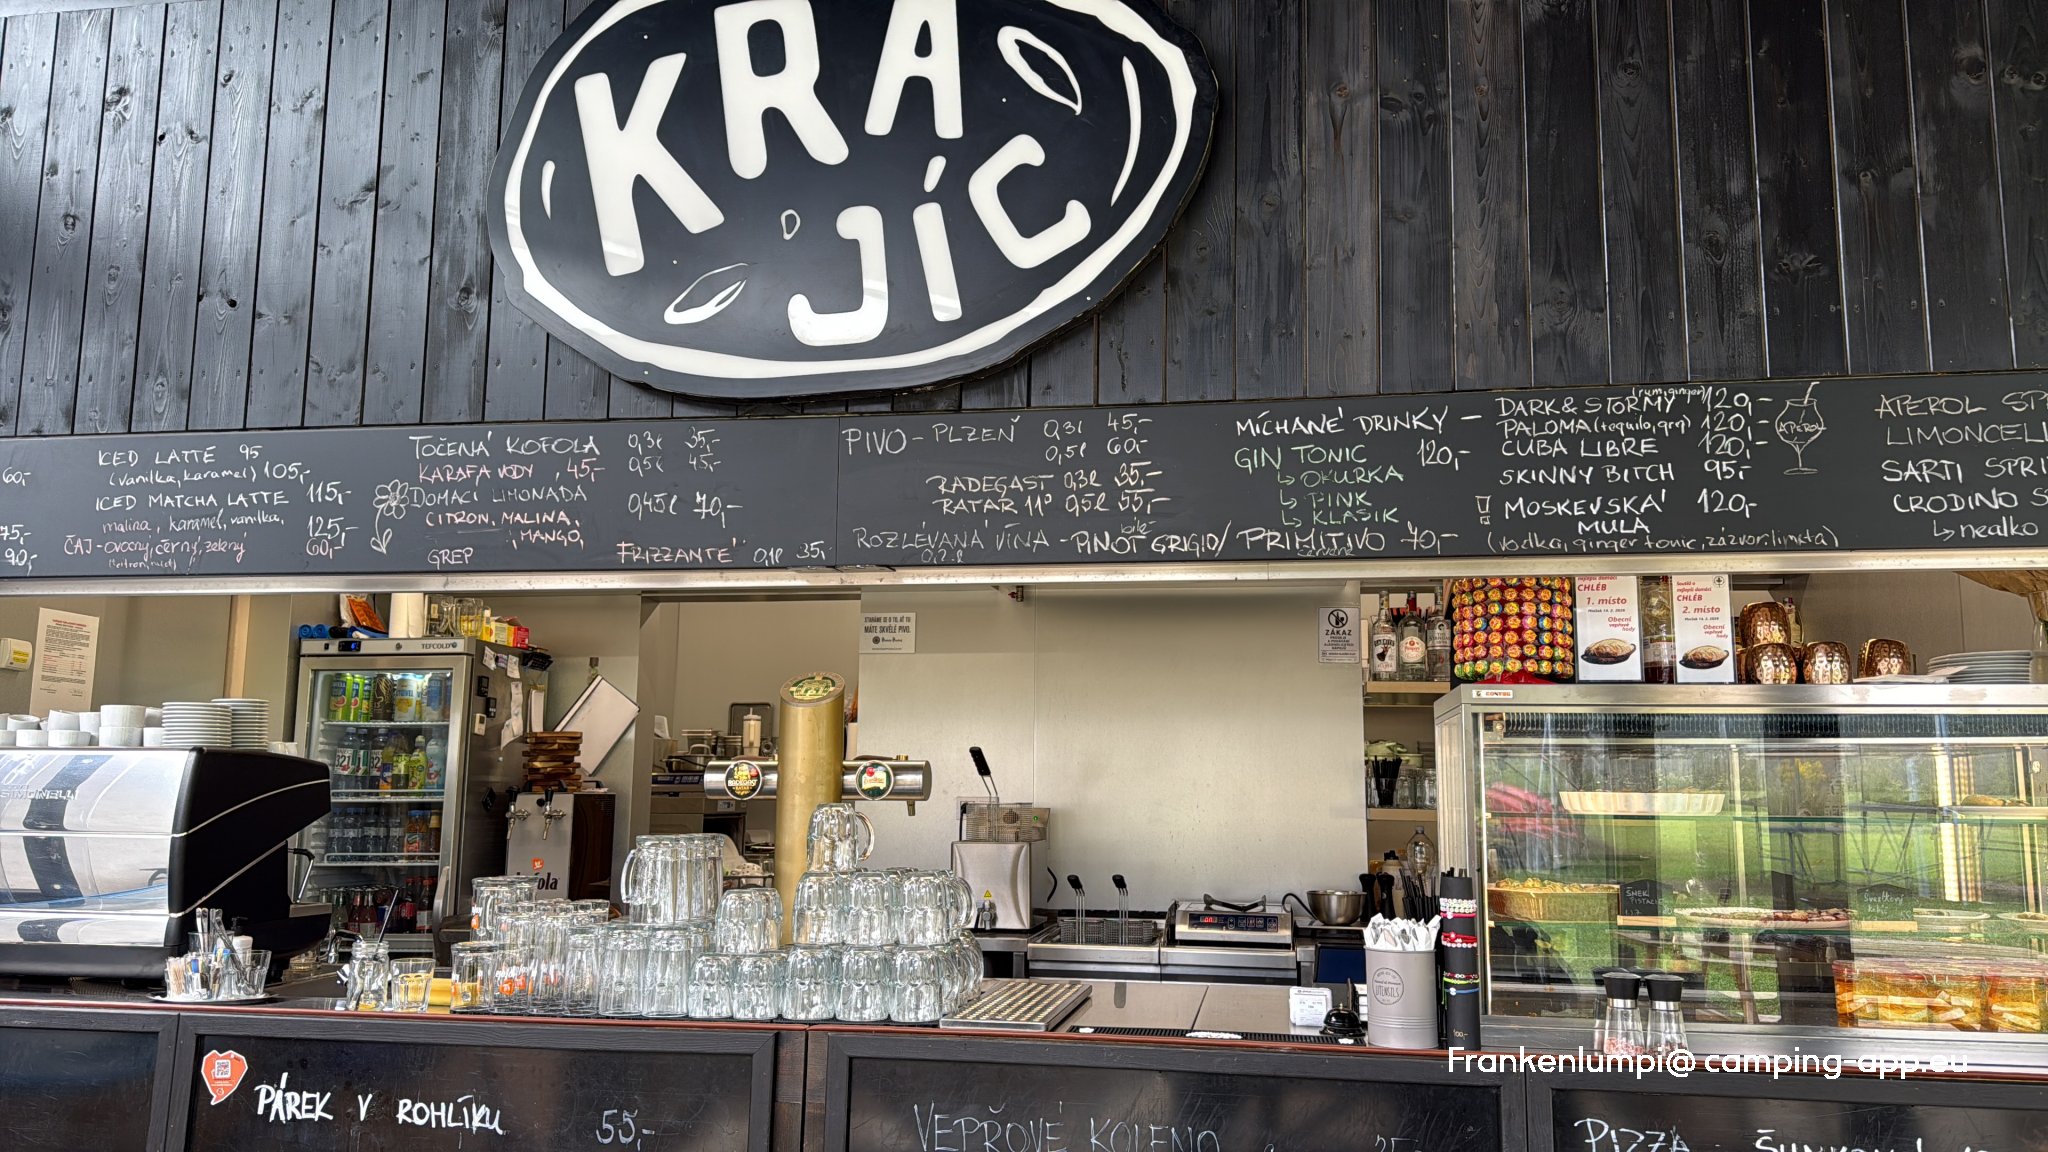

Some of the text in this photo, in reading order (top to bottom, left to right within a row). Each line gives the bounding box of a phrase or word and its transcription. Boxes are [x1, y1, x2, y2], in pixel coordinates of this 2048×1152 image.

[574, 0, 964, 278] KRA
[788, 134, 1092, 347] JÍC
[1584, 394, 1677, 415] STORMY
[1874, 394, 1988, 419] APEROL
[1236, 405, 1449, 437] MÍCHANÉ DRINKY
[1496, 418, 1592, 439] PALOMA
[506, 434, 601, 457] KOFOLA
[842, 427, 908, 455] PIVO
[932, 415, 1021, 443] PLZEŇ
[98, 450, 139, 467] ICED
[239, 444, 263, 461] 95
[1234, 438, 1472, 475] GIN TONIC 120,-
[1501, 440, 1568, 457] CUBA
[1580, 438, 1660, 458] LIBRE
[2, 466, 32, 487] 60,-
[418, 463, 491, 487] KARAFA
[1299, 464, 1404, 488] OKURKA
[1499, 466, 1595, 486] SKINNY
[1606, 462, 1676, 483] BITCH
[1881, 458, 1964, 484] SARTI
[95, 481, 352, 511] ICED MATCHA LATTE 115,-
[925, 474, 1055, 499] RADEGAST
[1304, 491, 1372, 508] PINK
[1893, 487, 2019, 514] CRODINO
[1311, 507, 1400, 526] KLASIK
[1578, 517, 1651, 535] MULA
[1960, 515, 2039, 539] nealko
[1070, 534, 1148, 555] PINOT
[1236, 526, 1386, 552] PRIMITIVO
[1572, 536, 1638, 554] ginger
[5, 548, 38, 576] 90,-
[427, 547, 474, 566] GREP
[1577, 582, 1607, 591] CHLÉB
[1676, 593, 1703, 601] CHLÉB
[1587, 596, 1627, 605] 1. místo
[1682, 605, 1721, 614] 2. místo
[254, 1072, 334, 1123] PÁREK
[596, 1109, 656, 1152] 55,-
